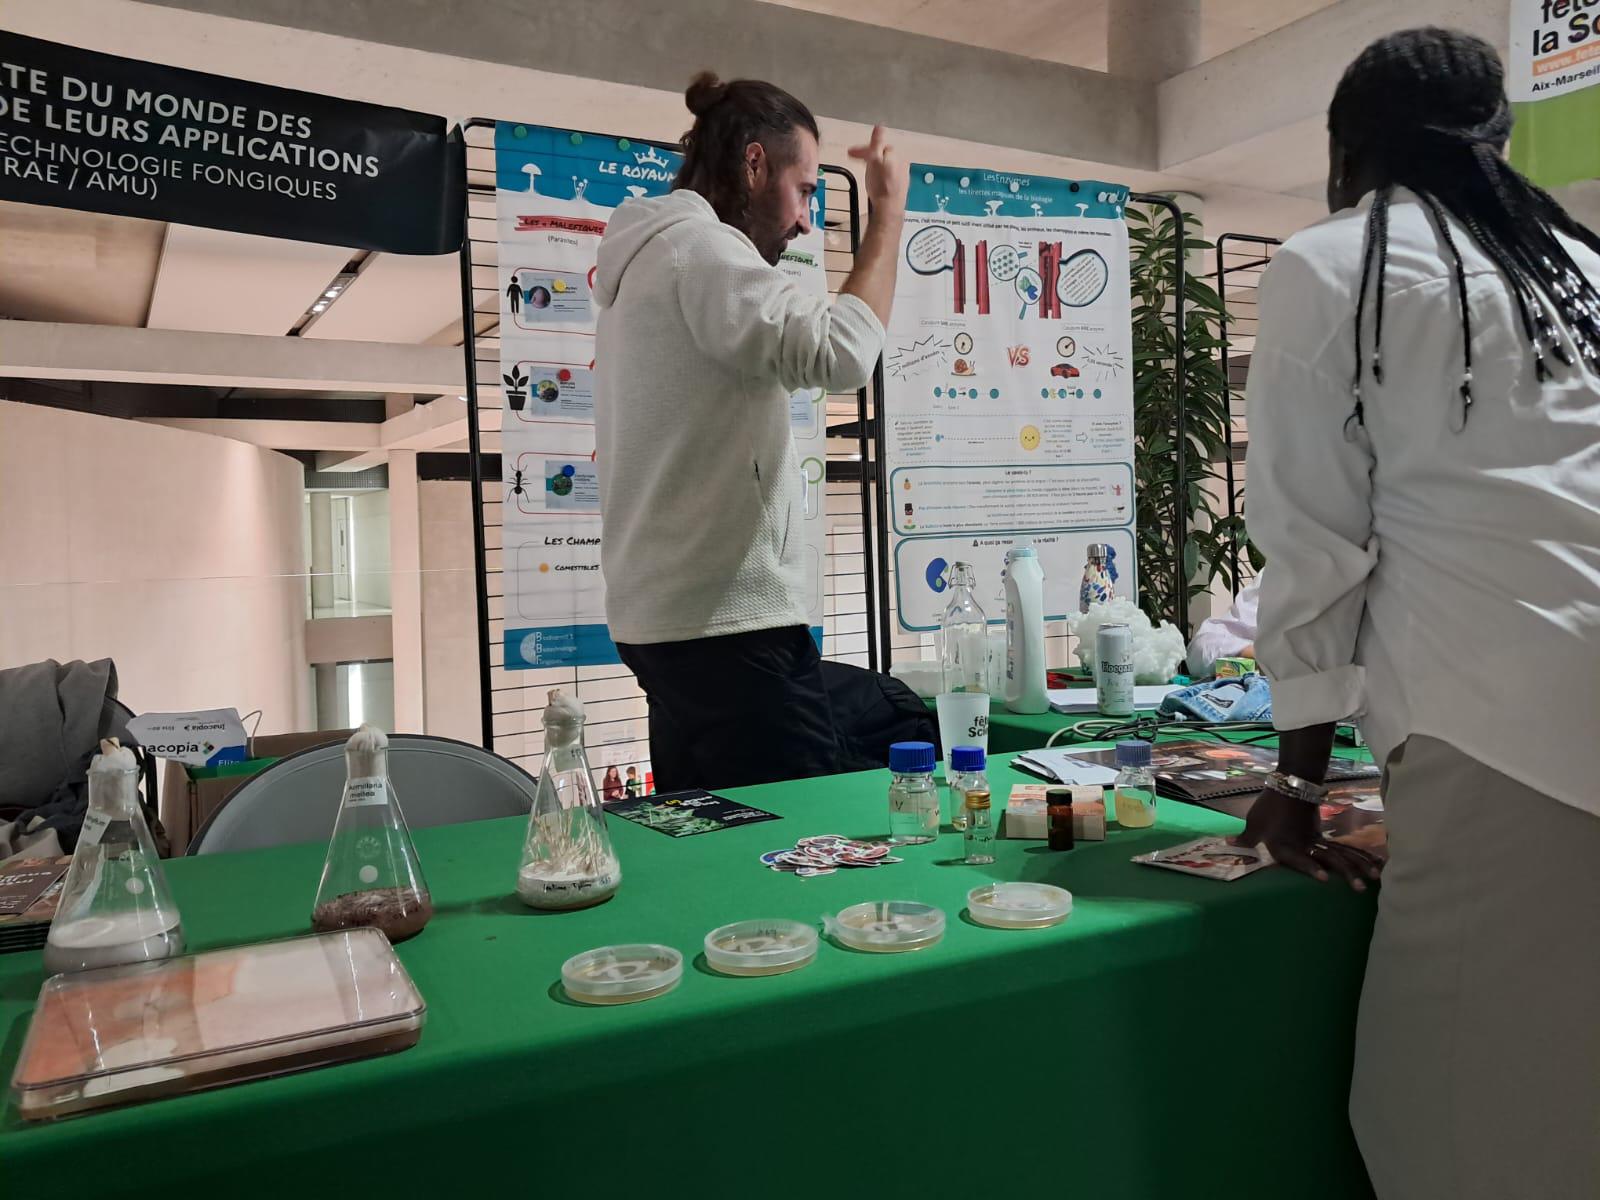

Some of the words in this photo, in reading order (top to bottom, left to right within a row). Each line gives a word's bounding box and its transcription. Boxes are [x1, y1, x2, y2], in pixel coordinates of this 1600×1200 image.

[1533, 29, 1559, 56] la
[0, 63, 47, 95] TE
[63, 76, 113, 107] DU
[126, 89, 247, 128] MONDE
[257, 110, 311, 139] DES
[46, 105, 149, 142] LEURS
[159, 125, 378, 177] APPLICATIONS
[5, 157, 58, 183] RAE
[68, 168, 78, 191] /
[87, 172, 157, 200] AMU)
[193, 163, 336, 200] FONGIQUES
[599, 161, 617, 174] LE
[1007, 345, 1029, 368] VS
[544, 536, 564, 545] LES
